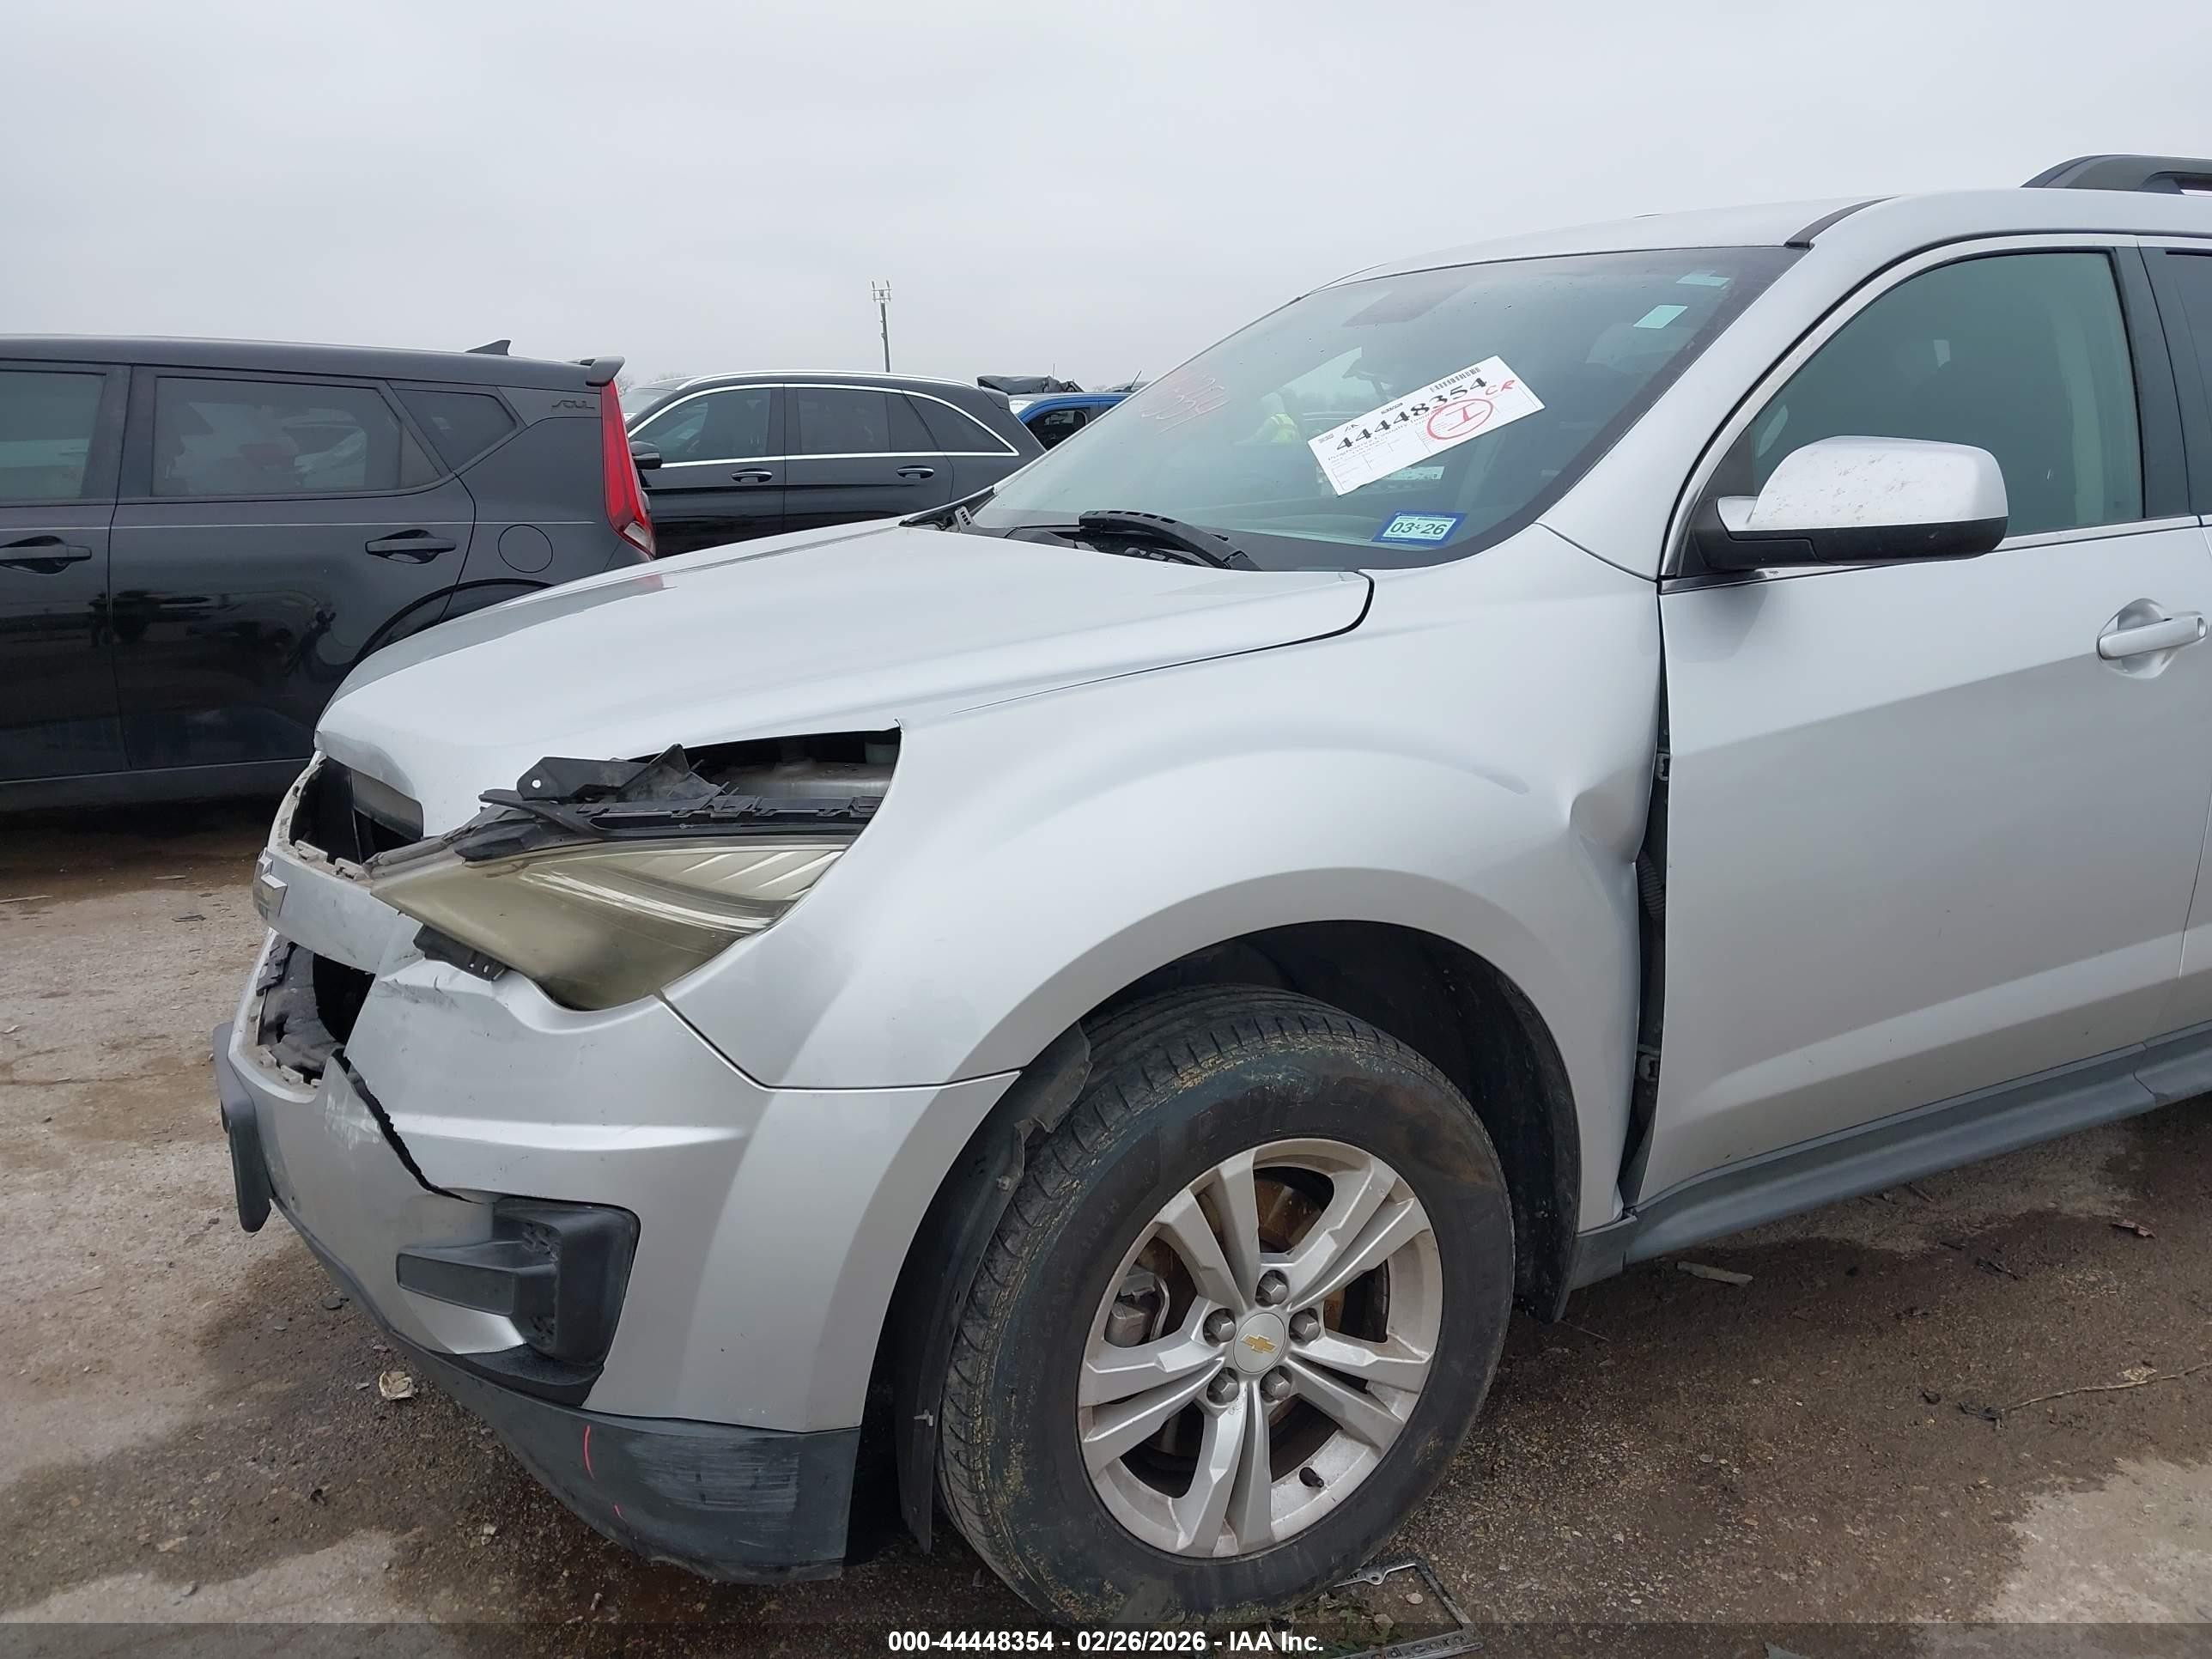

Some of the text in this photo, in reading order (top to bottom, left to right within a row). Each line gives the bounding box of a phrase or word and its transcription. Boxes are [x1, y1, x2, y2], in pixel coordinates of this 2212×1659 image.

[550, 399, 596, 410] SOUL
[1336, 376, 1488, 452] 44448354
[1390, 521, 1448, 535] 03 26
